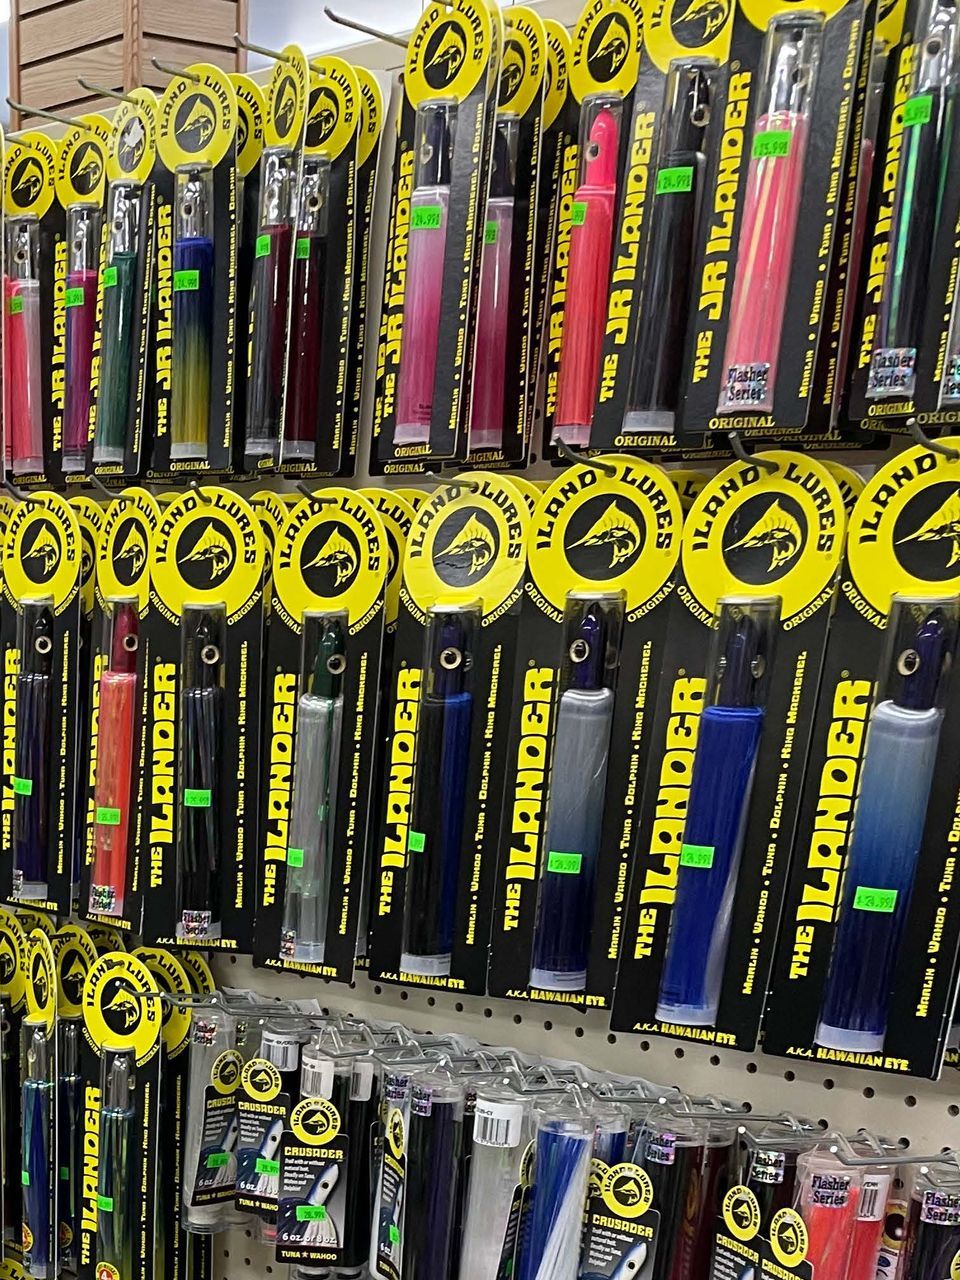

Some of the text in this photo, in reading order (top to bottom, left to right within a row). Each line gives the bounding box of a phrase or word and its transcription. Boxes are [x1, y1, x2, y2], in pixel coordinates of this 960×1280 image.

[409, 9, 439, 74] ILAND
[456, 0, 484, 60] LURES
[516, 19, 539, 77] LURES
[160, 80, 187, 138] ILAND
[204, 75, 231, 131] LURES
[692, 71, 752, 383] THE JR ILANDER
[798, 19, 860, 398] MARLIN WAHOO TUNA KING MACKEREL DOLPHIN
[383, 150, 415, 417] THE JR ILANDER
[599, 112, 655, 403] THE JR ILANDER
[156, 204, 173, 437] THE JR ILANDER
[728, 385, 764, 401] Series
[394, 444, 432, 457] ORIGINAL
[614, 435, 678, 447] ORIGINAL
[708, 416, 776, 430] ORIGINAL
[169, 461, 210, 472] ORIGINAL
[410, 481, 523, 559] ILAND LURES
[537, 466, 673, 550] ILAND LURES
[692, 462, 836, 552] ILAND LURES
[859, 452, 937, 545] ILAND
[156, 496, 256, 565] ILAND LURES
[481, 587, 524, 627] ORIGINAL
[627, 581, 675, 623] ORIGINAL
[842, 581, 888, 631] ORIGINAL
[149, 663, 177, 887] THE ILANDER
[378, 668, 424, 916] THE ILANDER
[504, 667, 554, 931] THE ILANDER
[634, 677, 707, 959] THE ILANDER
[742, 651, 807, 995] MARLIN WAHOO TUNA DOLPHIN KING MACKEREL
[789, 679, 872, 980] THE ILANDER
[916, 856, 956, 1017] MARLIN WAHOO TUNA
[506, 989, 605, 1008] A.K.A. HAWAIIAN EYE
[633, 1022, 737, 1046] A.K.A. HAWAIIAN EYE
[786, 1046, 909, 1071] A.K.A. HAWAIIAN EYE
[238, 1101, 286, 1115] CRUSADER
[81, 1086, 102, 1265] THE ILANDER
[284, 1146, 344, 1159] CRUSADER
[811, 1176, 851, 1191] Flasher
[812, 1190, 847, 1206] Series
[282, 1233, 288, 1241] 6
[592, 1214, 654, 1238] CRUSADER
[717, 1233, 759, 1263] CRUSADER
[281, 1250, 337, 1261] TUNA WAHOO
